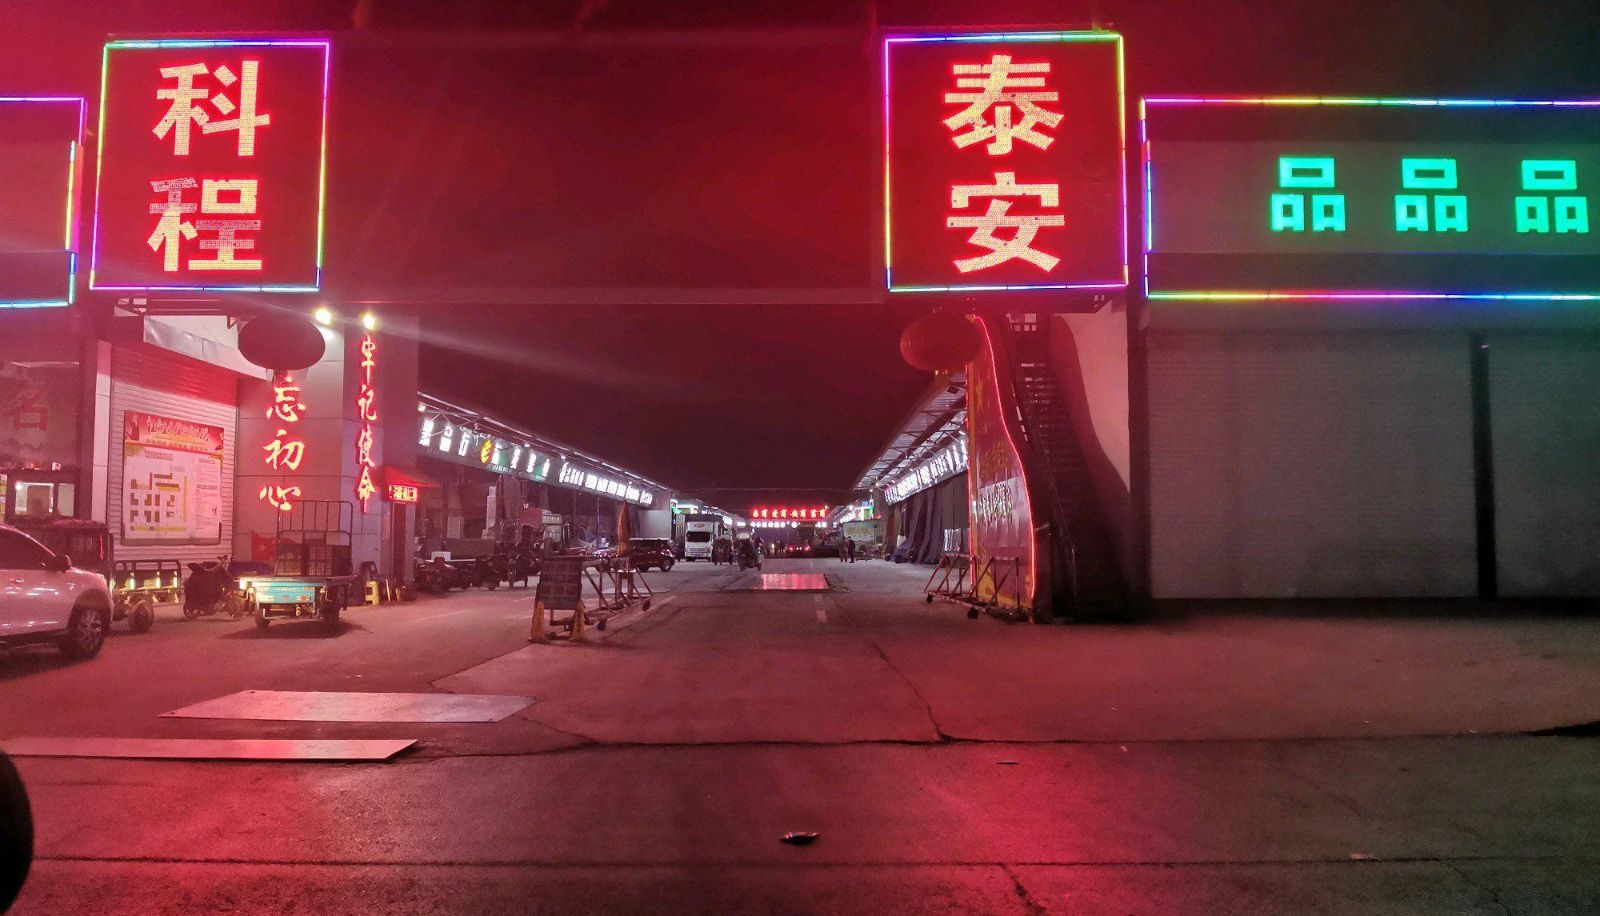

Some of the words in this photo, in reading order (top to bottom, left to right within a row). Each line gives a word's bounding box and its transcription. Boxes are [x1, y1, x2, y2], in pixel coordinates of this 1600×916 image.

[151, 59, 271, 272] 科程
[943, 54, 1065, 273] 泰安
[1269, 155, 1589, 235] 品品品
[259, 377, 308, 512] 忘初心
[356, 333, 379, 513] 牢记使命
